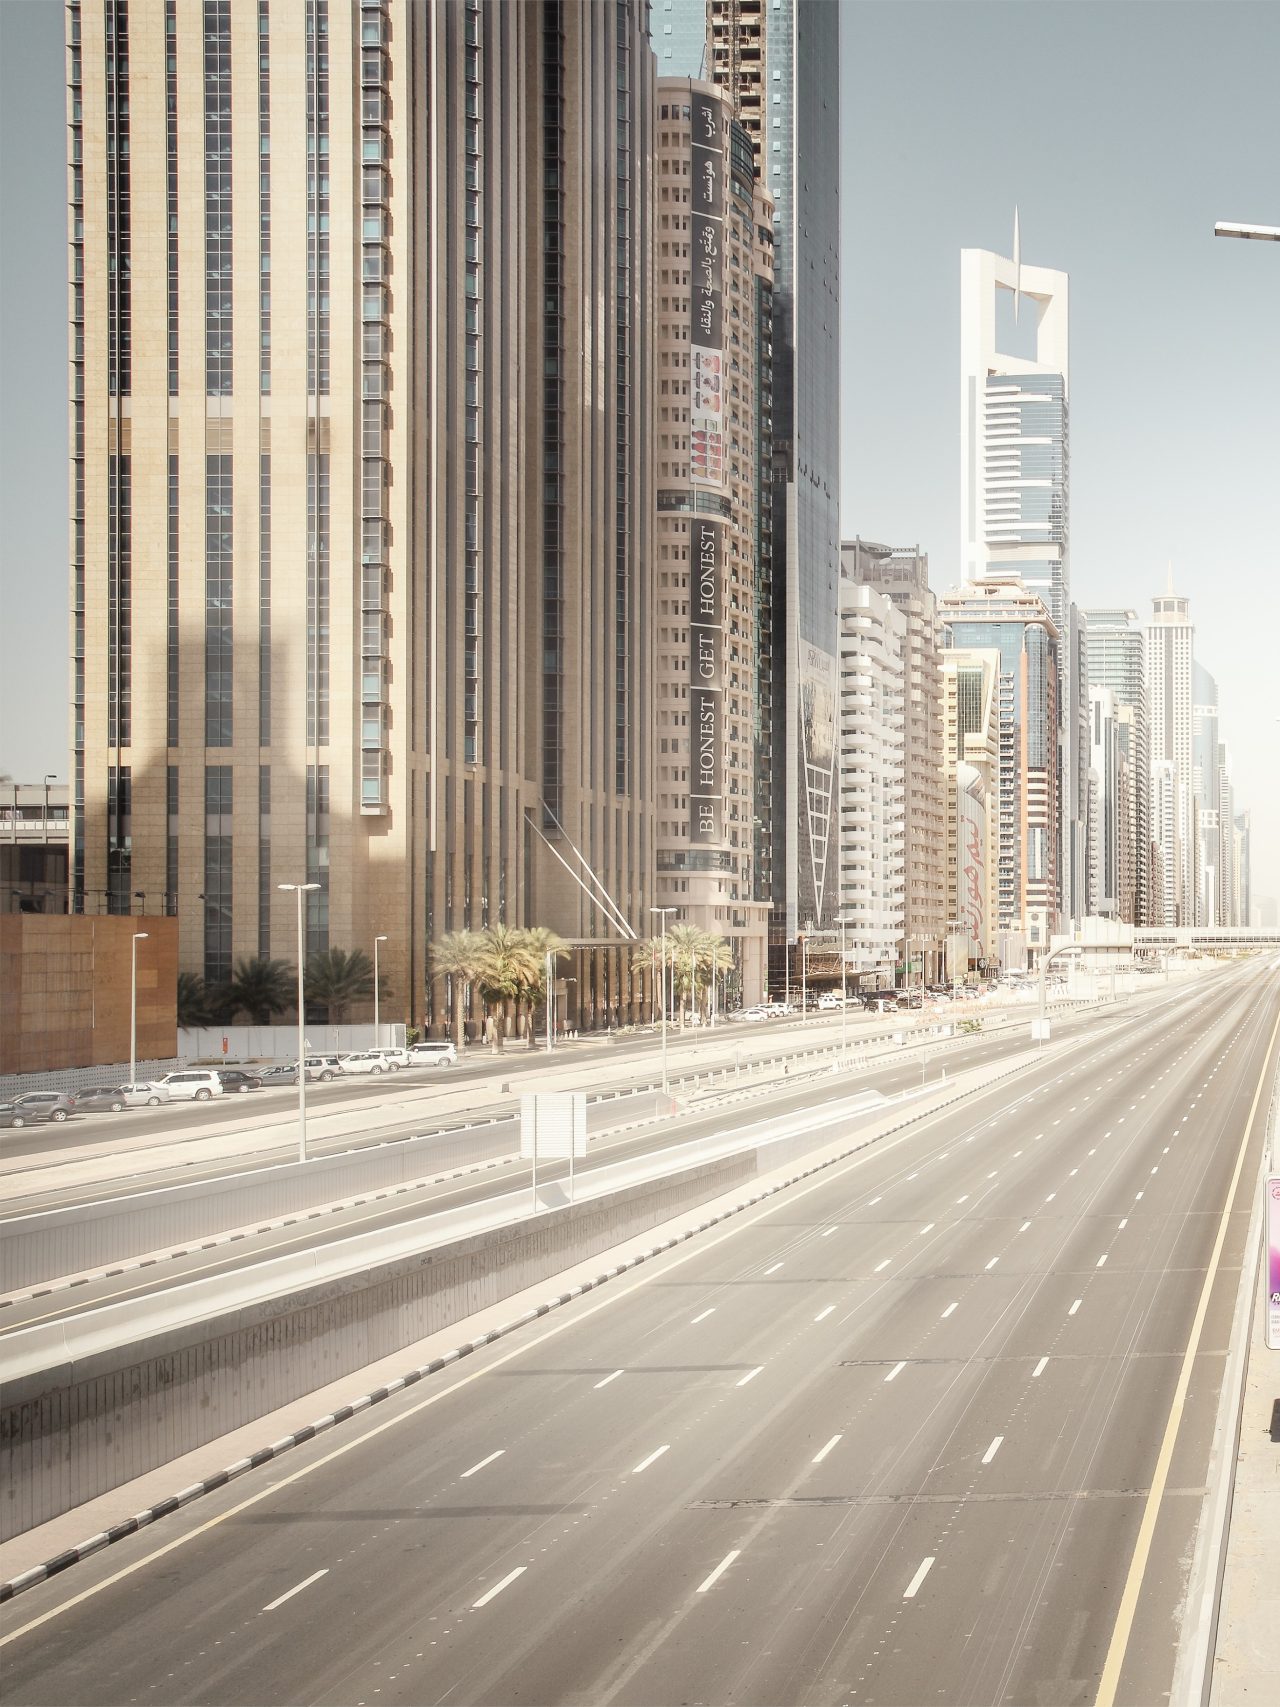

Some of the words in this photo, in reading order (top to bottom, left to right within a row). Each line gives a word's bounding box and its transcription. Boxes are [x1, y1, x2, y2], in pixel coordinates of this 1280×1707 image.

[700, 106, 715, 138] اشرب
[703, 159, 715, 203] هونست
[699, 525, 717, 616] HONEST
[699, 633, 716, 680] GET
[699, 697, 716, 787] HONEST
[699, 804, 715, 835] BE
